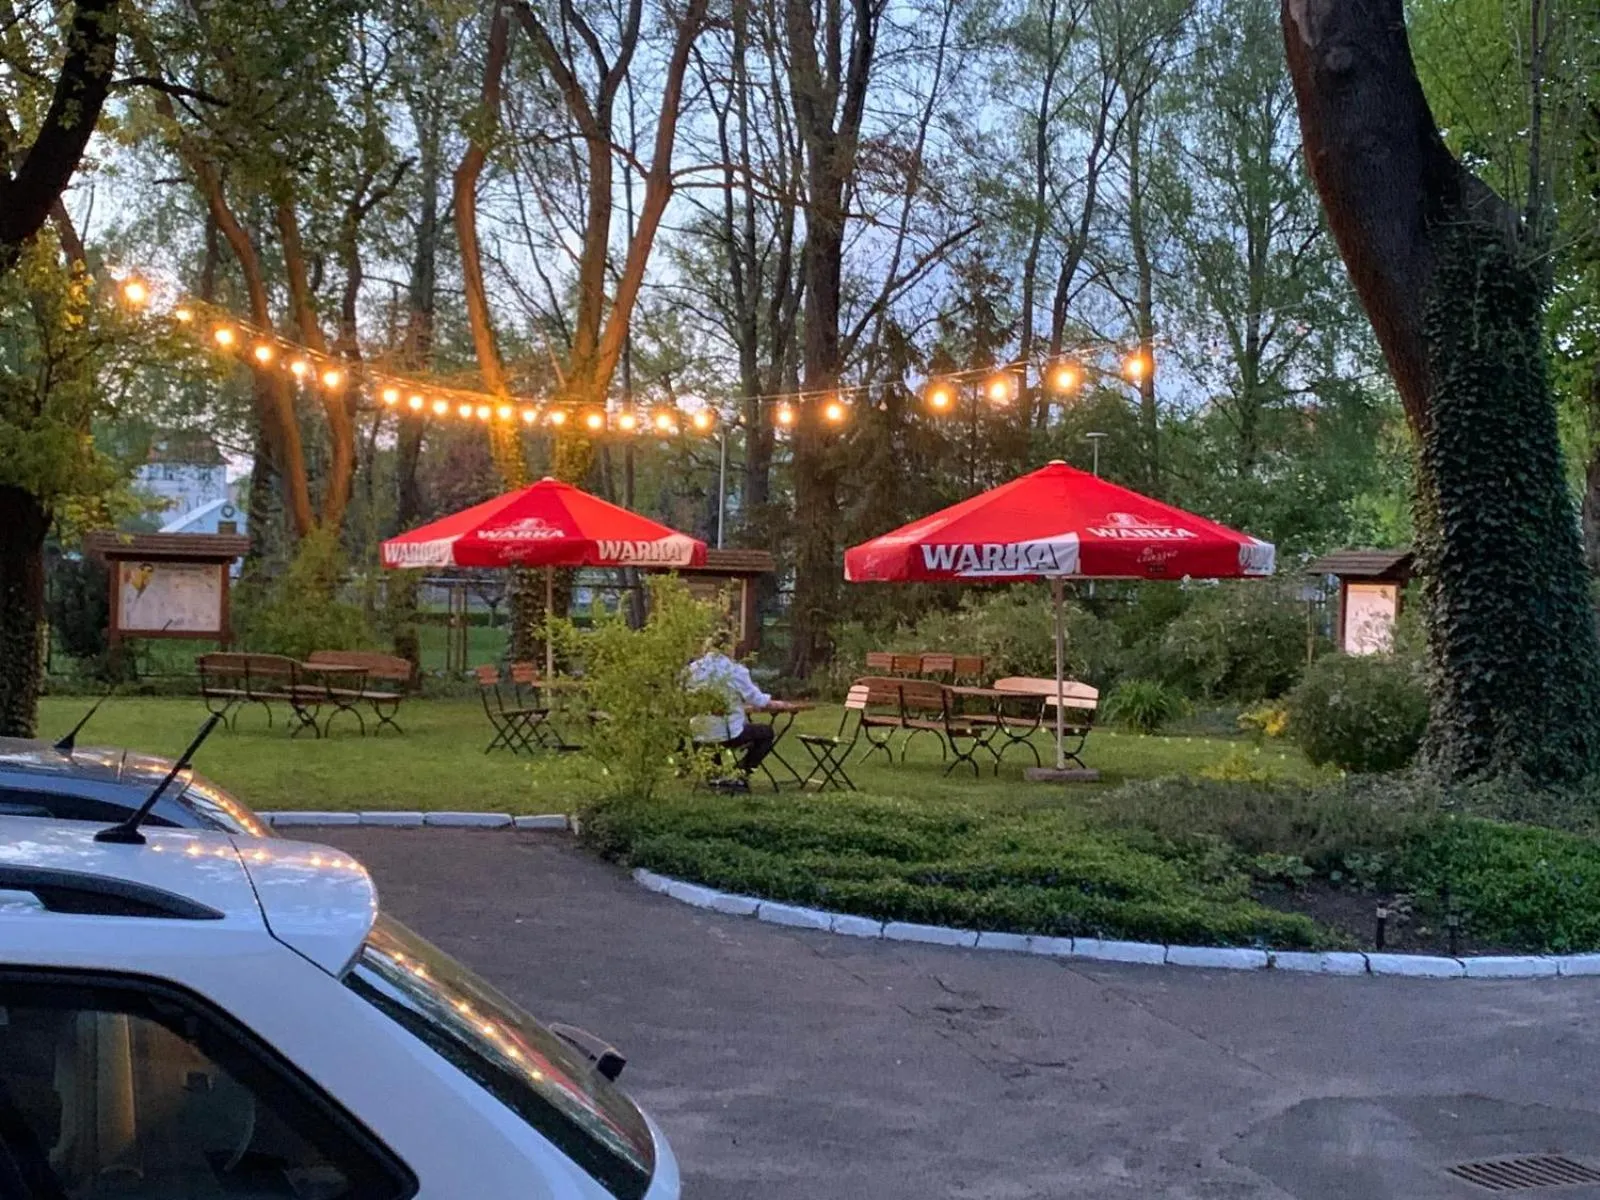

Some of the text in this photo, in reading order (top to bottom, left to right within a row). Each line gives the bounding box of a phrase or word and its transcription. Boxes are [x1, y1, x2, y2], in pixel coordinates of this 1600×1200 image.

[477, 530, 565, 538] WARKA
[1085, 527, 1199, 538] WARKA
[596, 540, 682, 561] WARKA
[920, 543, 1059, 571] WARKA
